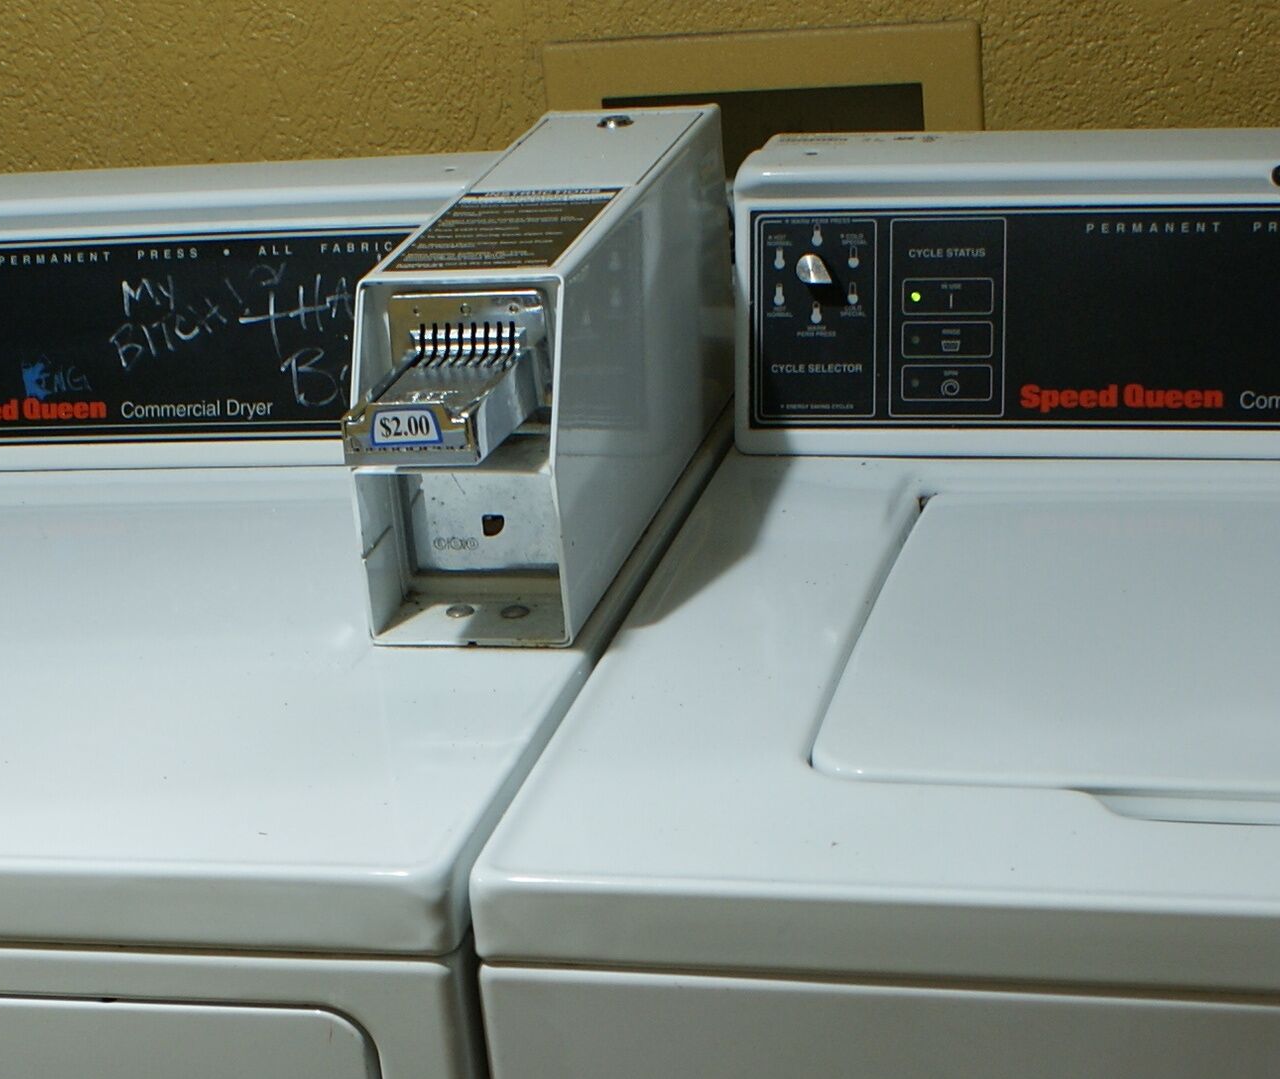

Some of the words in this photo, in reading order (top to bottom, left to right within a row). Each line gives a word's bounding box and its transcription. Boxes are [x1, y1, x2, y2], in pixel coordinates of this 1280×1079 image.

[1085, 221, 1222, 234] PERMANENT
[137, 247, 198, 260] PRESS
[258, 245, 292, 257] ALL
[320, 240, 393, 254] FABRIC
[908, 248, 944, 259] CYCLE
[946, 247, 986, 258] STATUS
[771, 363, 806, 374] CYCLE
[807, 363, 863, 374] SELECTOR
[1020, 384, 1118, 413] Speed
[1123, 383, 1224, 408] Queen
[23, 398, 107, 420] Queen
[121, 400, 221, 419] Commercial
[226, 400, 274, 420] Dryer
[380, 414, 431, 438] $2.00
